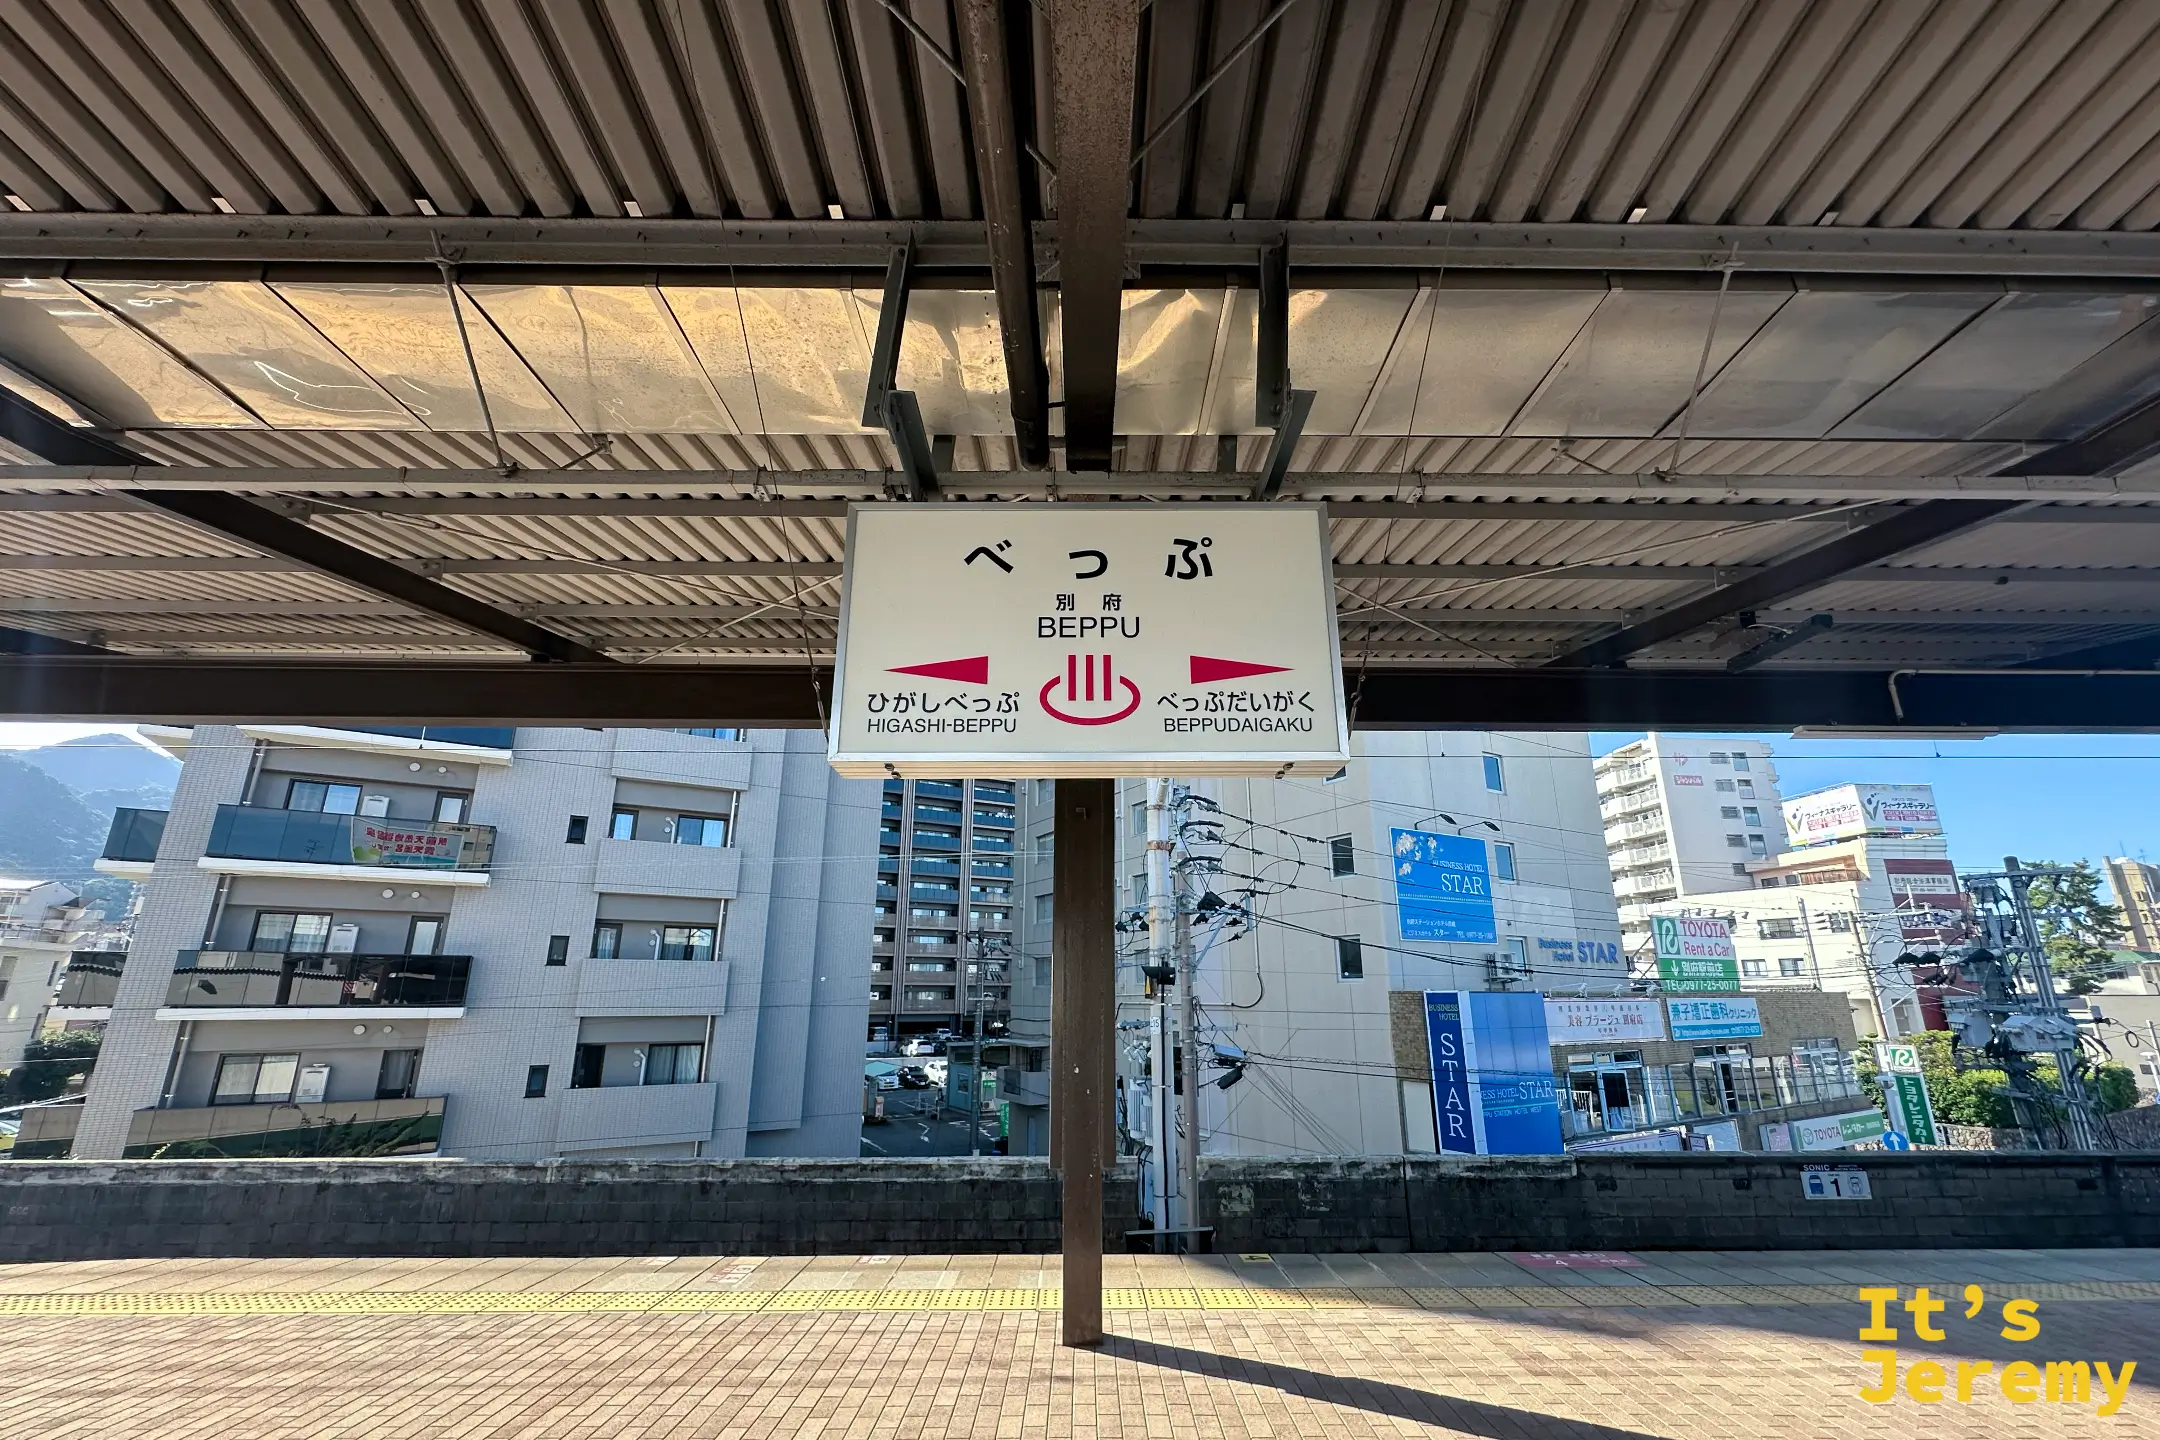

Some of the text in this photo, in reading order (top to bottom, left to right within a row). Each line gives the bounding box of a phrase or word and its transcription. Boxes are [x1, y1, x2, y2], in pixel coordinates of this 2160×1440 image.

[963, 536, 1214, 580] べっぷ
[1055, 592, 1122, 612] 別府
[1037, 616, 1141, 639] BEPPU
[867, 691, 1020, 714] ひがしべっぷ
[1157, 690, 1315, 713] べっぷだいがく
[866, 717, 1017, 733] HIGASHI-BEPPU
[1163, 717, 1314, 732] BEPPUDAIGAKU
[1441, 873, 1485, 895] STAR
[1680, 920, 1729, 938] TOYOTA
[1577, 941, 1619, 964] STAR
[1683, 941, 1730, 956] Rent a Car
[1428, 1003, 1459, 1013] BUSINESS
[1438, 1013, 1460, 1021] HOTEL
[1440, 1032, 1467, 1139] STAR
[1518, 1080, 1554, 1100] STAR
[1902, 1077, 1928, 1144] トヨタレンタカー
[1813, 1125, 1842, 1141] TOYOTA
[1803, 1164, 1831, 1172] SONIC
[1830, 1177, 1842, 1197] 1
